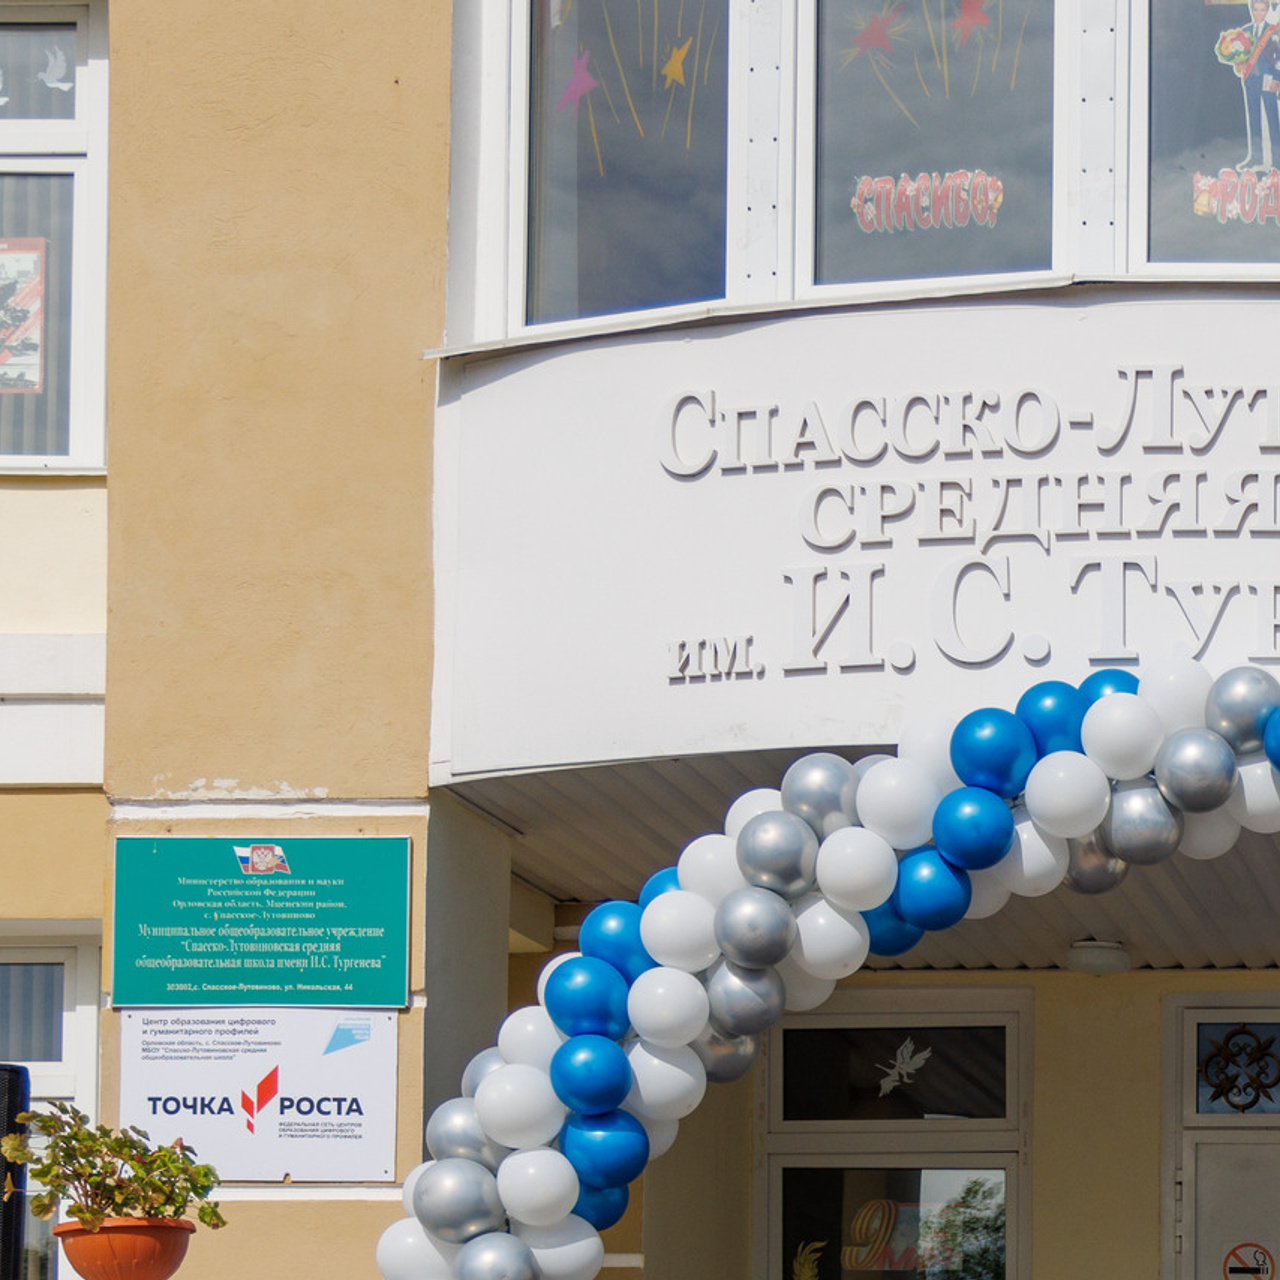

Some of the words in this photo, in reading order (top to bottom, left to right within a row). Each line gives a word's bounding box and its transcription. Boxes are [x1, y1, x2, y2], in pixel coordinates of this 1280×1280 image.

[177, 877, 245, 887] Министерство
[246, 877, 306, 886] образования
[316, 879, 344, 887] науки
[207, 888, 261, 897] Российской
[264, 889, 316, 897] Федерации
[172, 900, 222, 909] Орловская
[138, 924, 217, 938] Муниципальное
[218, 924, 325, 939] общеобразовательное
[325, 927, 385, 940] учреждение
[302, 942, 341, 955] средняя
[135, 955, 241, 971] общеобразовательная
[244, 958, 274, 968] школа
[277, 958, 308, 968] имени
[142, 1018, 168, 1026] Центр
[170, 1018, 226, 1026] образования
[227, 1018, 277, 1026] цифрового
[215, 1028, 259, 1036] профилей
[148, 1096, 234, 1115] ТОЧКА
[279, 1096, 364, 1116] РОСТА
